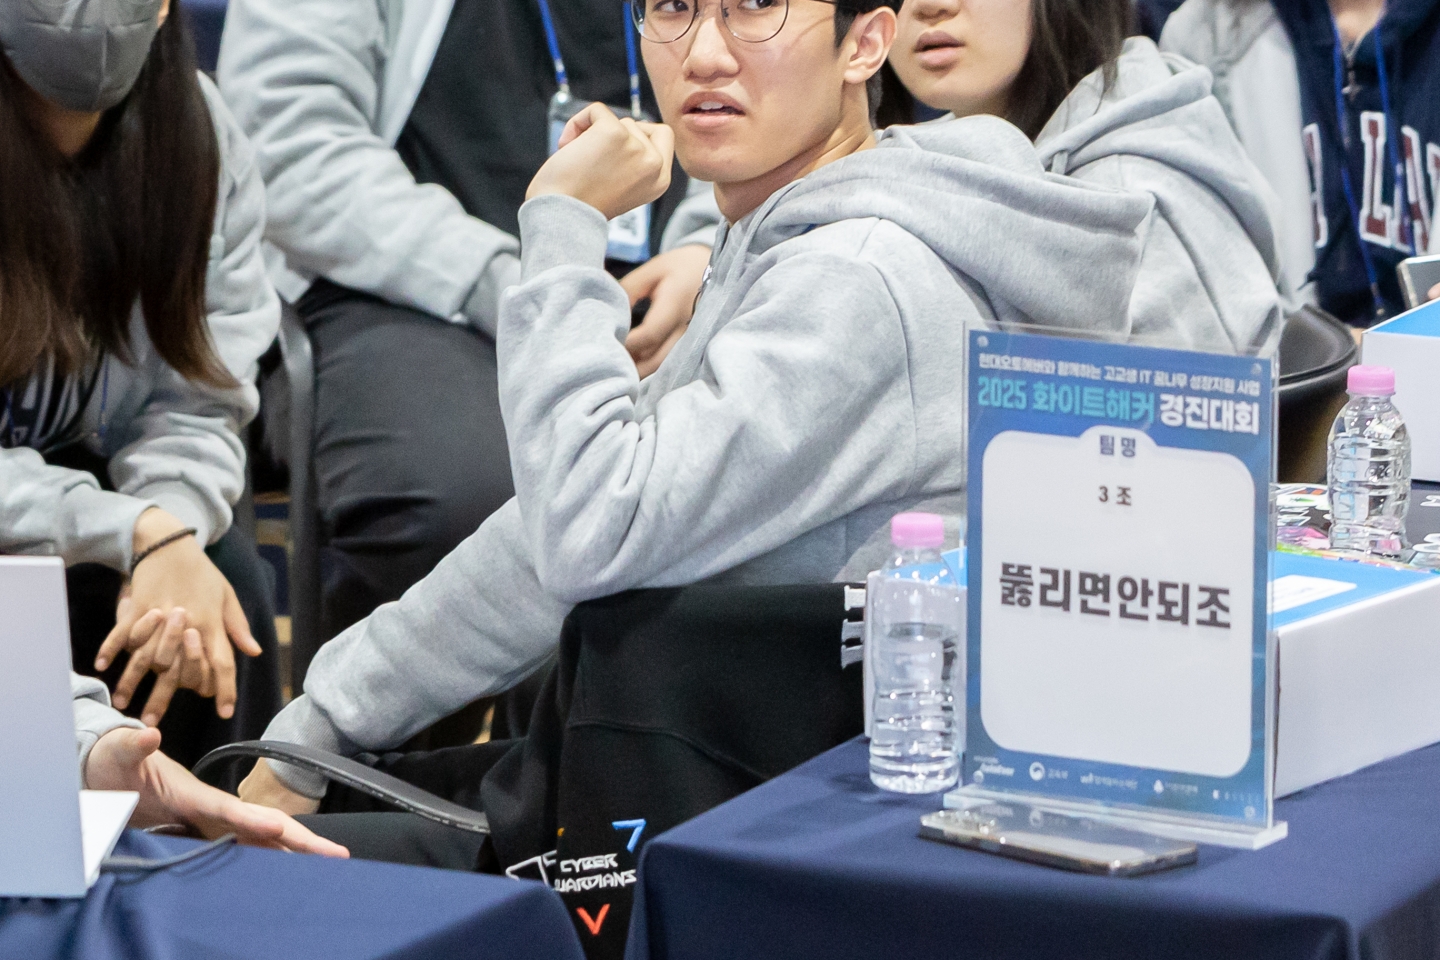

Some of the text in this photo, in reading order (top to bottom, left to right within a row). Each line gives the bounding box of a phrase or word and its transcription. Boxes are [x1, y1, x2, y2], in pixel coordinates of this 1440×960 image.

[1103, 365, 1138, 384] 고교생
[1139, 369, 1152, 384] IT
[1189, 374, 1236, 394] 성장지원
[1237, 379, 1260, 397] 사업
[978, 375, 1260, 435] 2025 화이트해커 경진대회
[999, 562, 1231, 629] 뚫리면안되조
[560, 853, 618, 873] CYBER
[554, 869, 637, 893] UARDIANS
